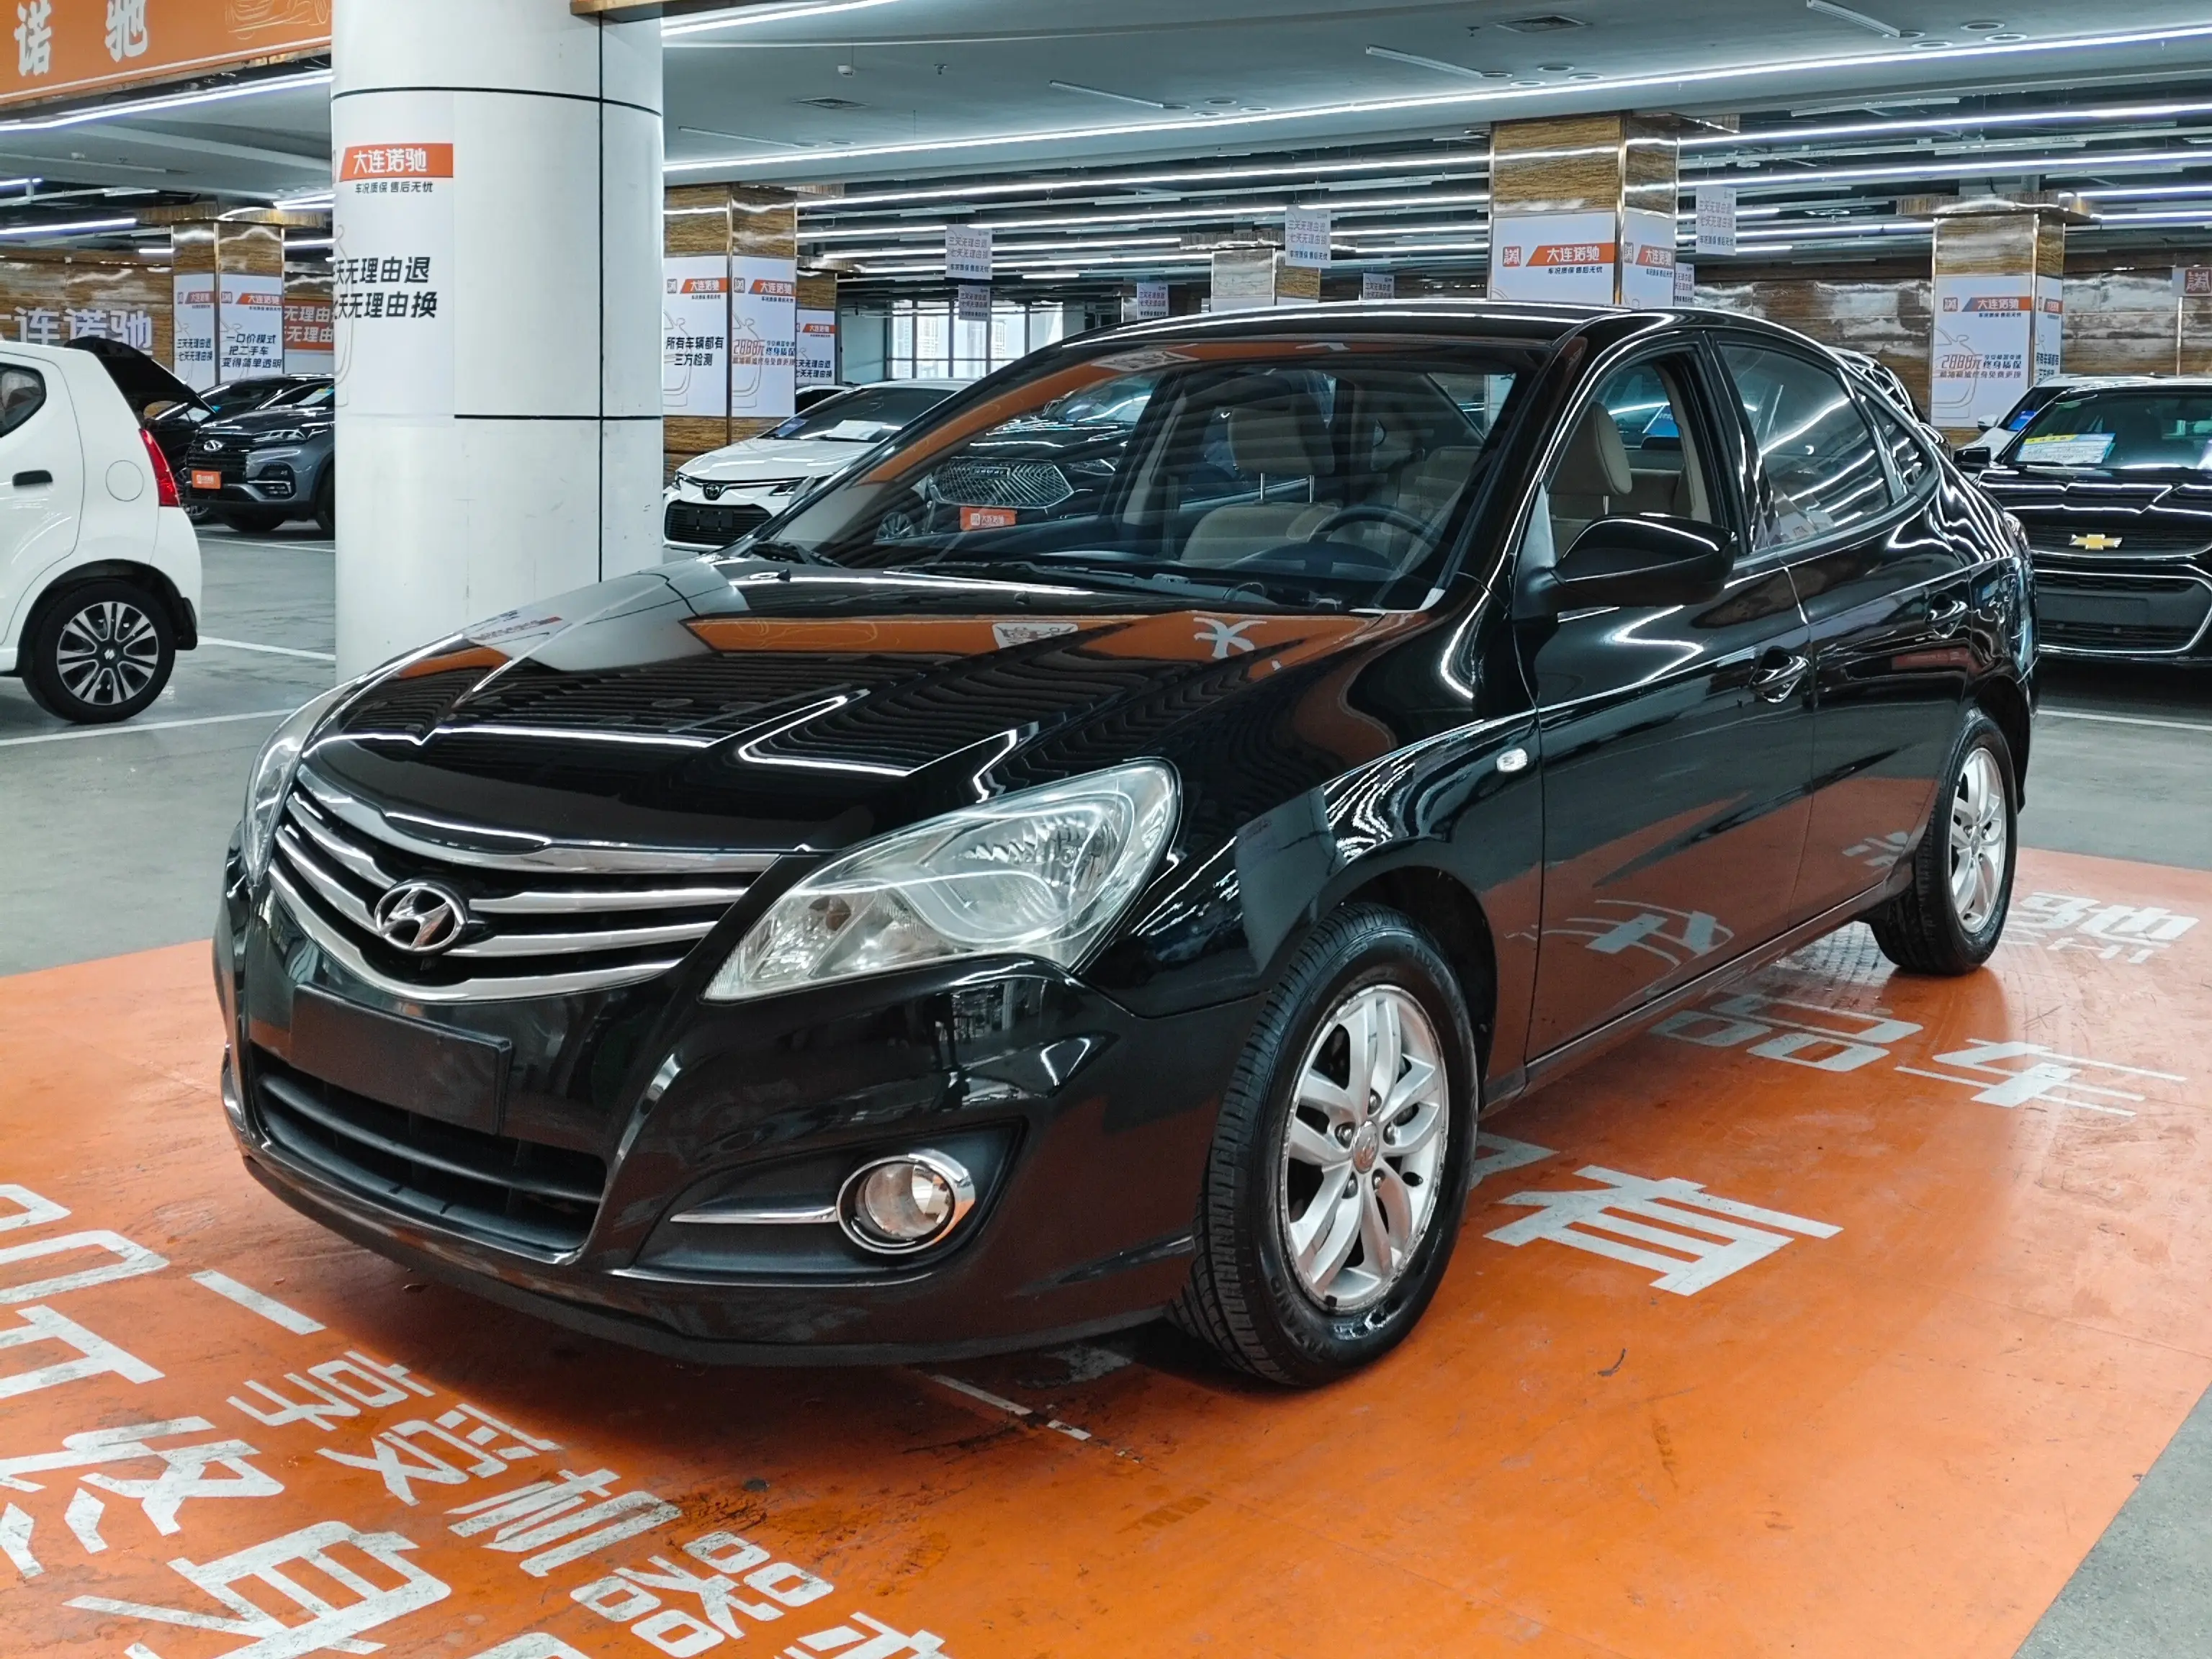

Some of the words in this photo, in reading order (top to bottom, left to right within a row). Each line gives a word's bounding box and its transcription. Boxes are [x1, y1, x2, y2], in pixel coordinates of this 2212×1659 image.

[354, 148, 427, 174] 大连诺驰
[390, 181, 433, 193] 售后无忧
[1547, 247, 1600, 263] 大连诺驰
[333, 256, 431, 285] 天无理由退
[0, 306, 153, 355] 连诺驰
[226, 333, 276, 344] 一口价模式
[666, 336, 724, 350] 所有车辆都有
[229, 346, 269, 356] 把二手车
[221, 357, 282, 369] 变得简单透明
[674, 353, 713, 366] 三方检测
